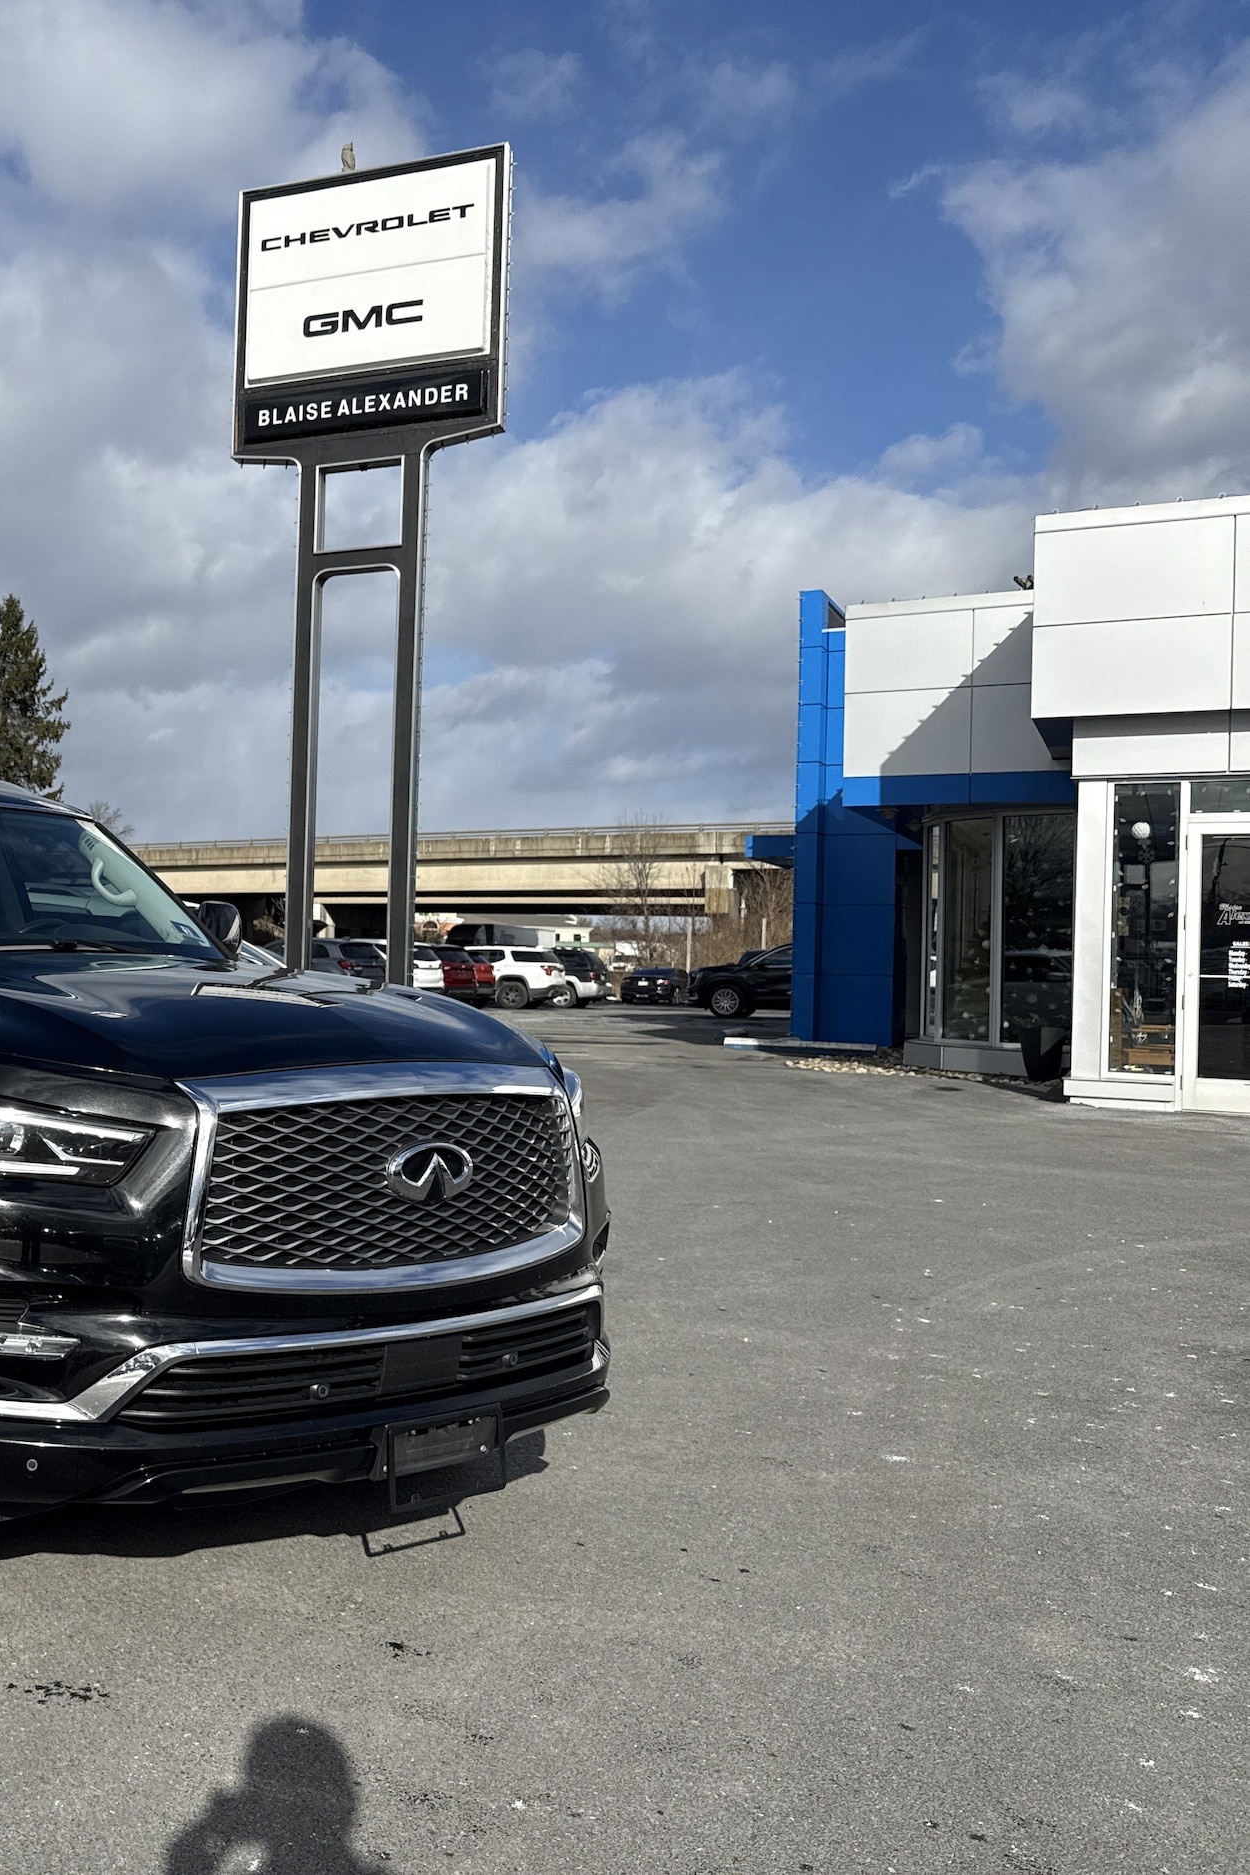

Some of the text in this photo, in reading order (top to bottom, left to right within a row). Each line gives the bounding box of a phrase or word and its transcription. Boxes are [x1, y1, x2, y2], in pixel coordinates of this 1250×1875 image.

[261, 203, 475, 251] CHEVROLET
[303, 299, 423, 338] GMC
[258, 383, 469, 427] BLAISE ALEXANDER
